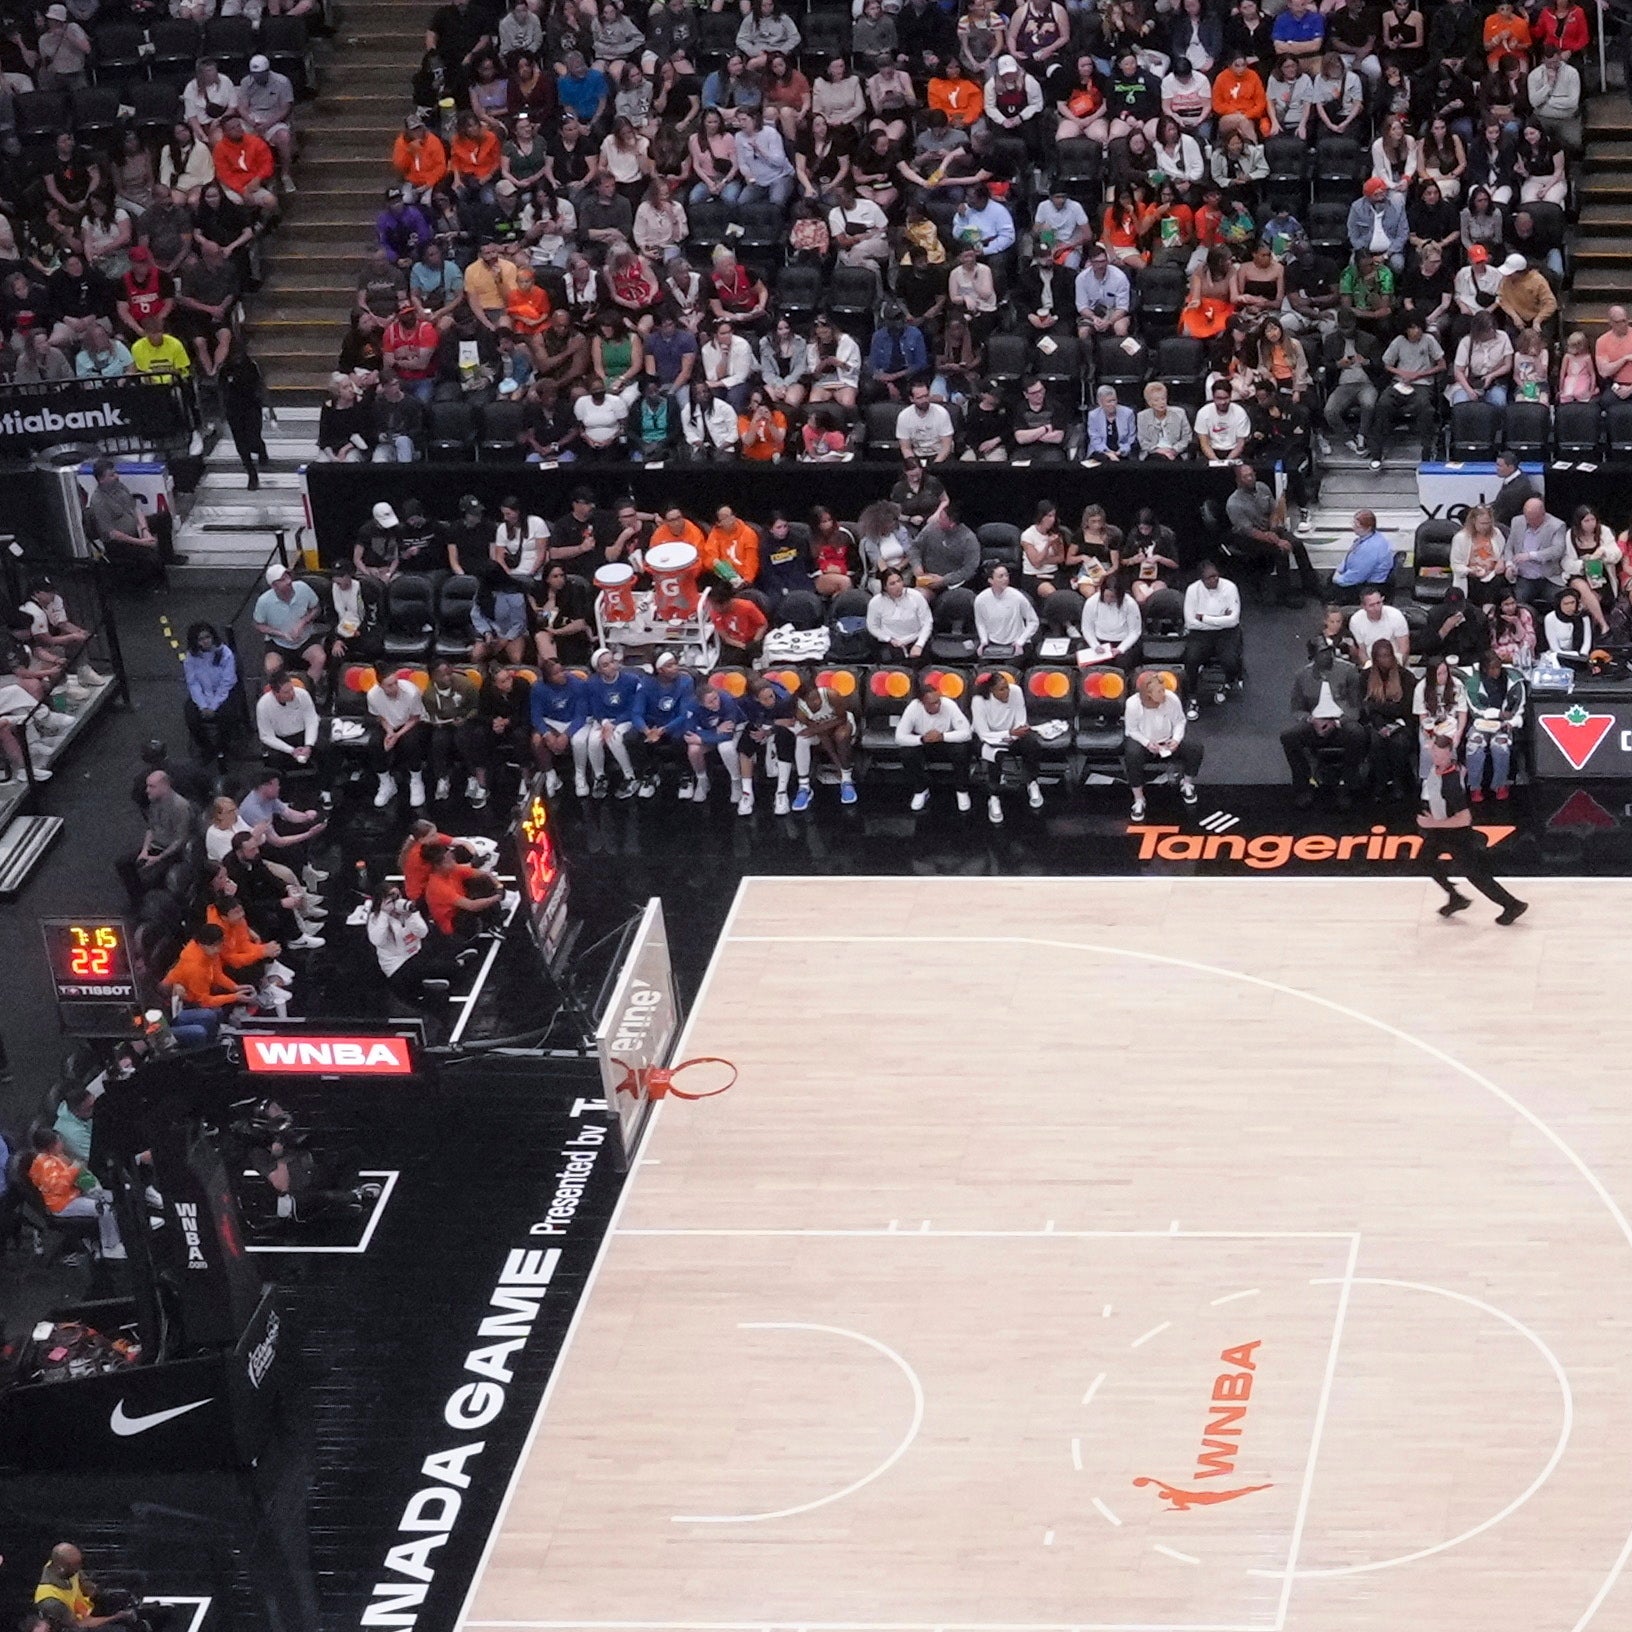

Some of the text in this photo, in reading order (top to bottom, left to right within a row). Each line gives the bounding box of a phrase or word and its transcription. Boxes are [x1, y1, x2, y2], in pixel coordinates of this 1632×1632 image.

[0, 402, 124, 434] tiabank
[1126, 824, 1424, 870] Tangerin
[70, 927, 119, 949] 7:15
[70, 947, 111, 975] 22
[255, 1042, 400, 1066] WNBA
[444, 1247, 562, 1431] GAME
[529, 1150, 598, 1235] Presented
[565, 1124, 608, 1146] by
[1193, 1339, 1262, 1480] WNBA
